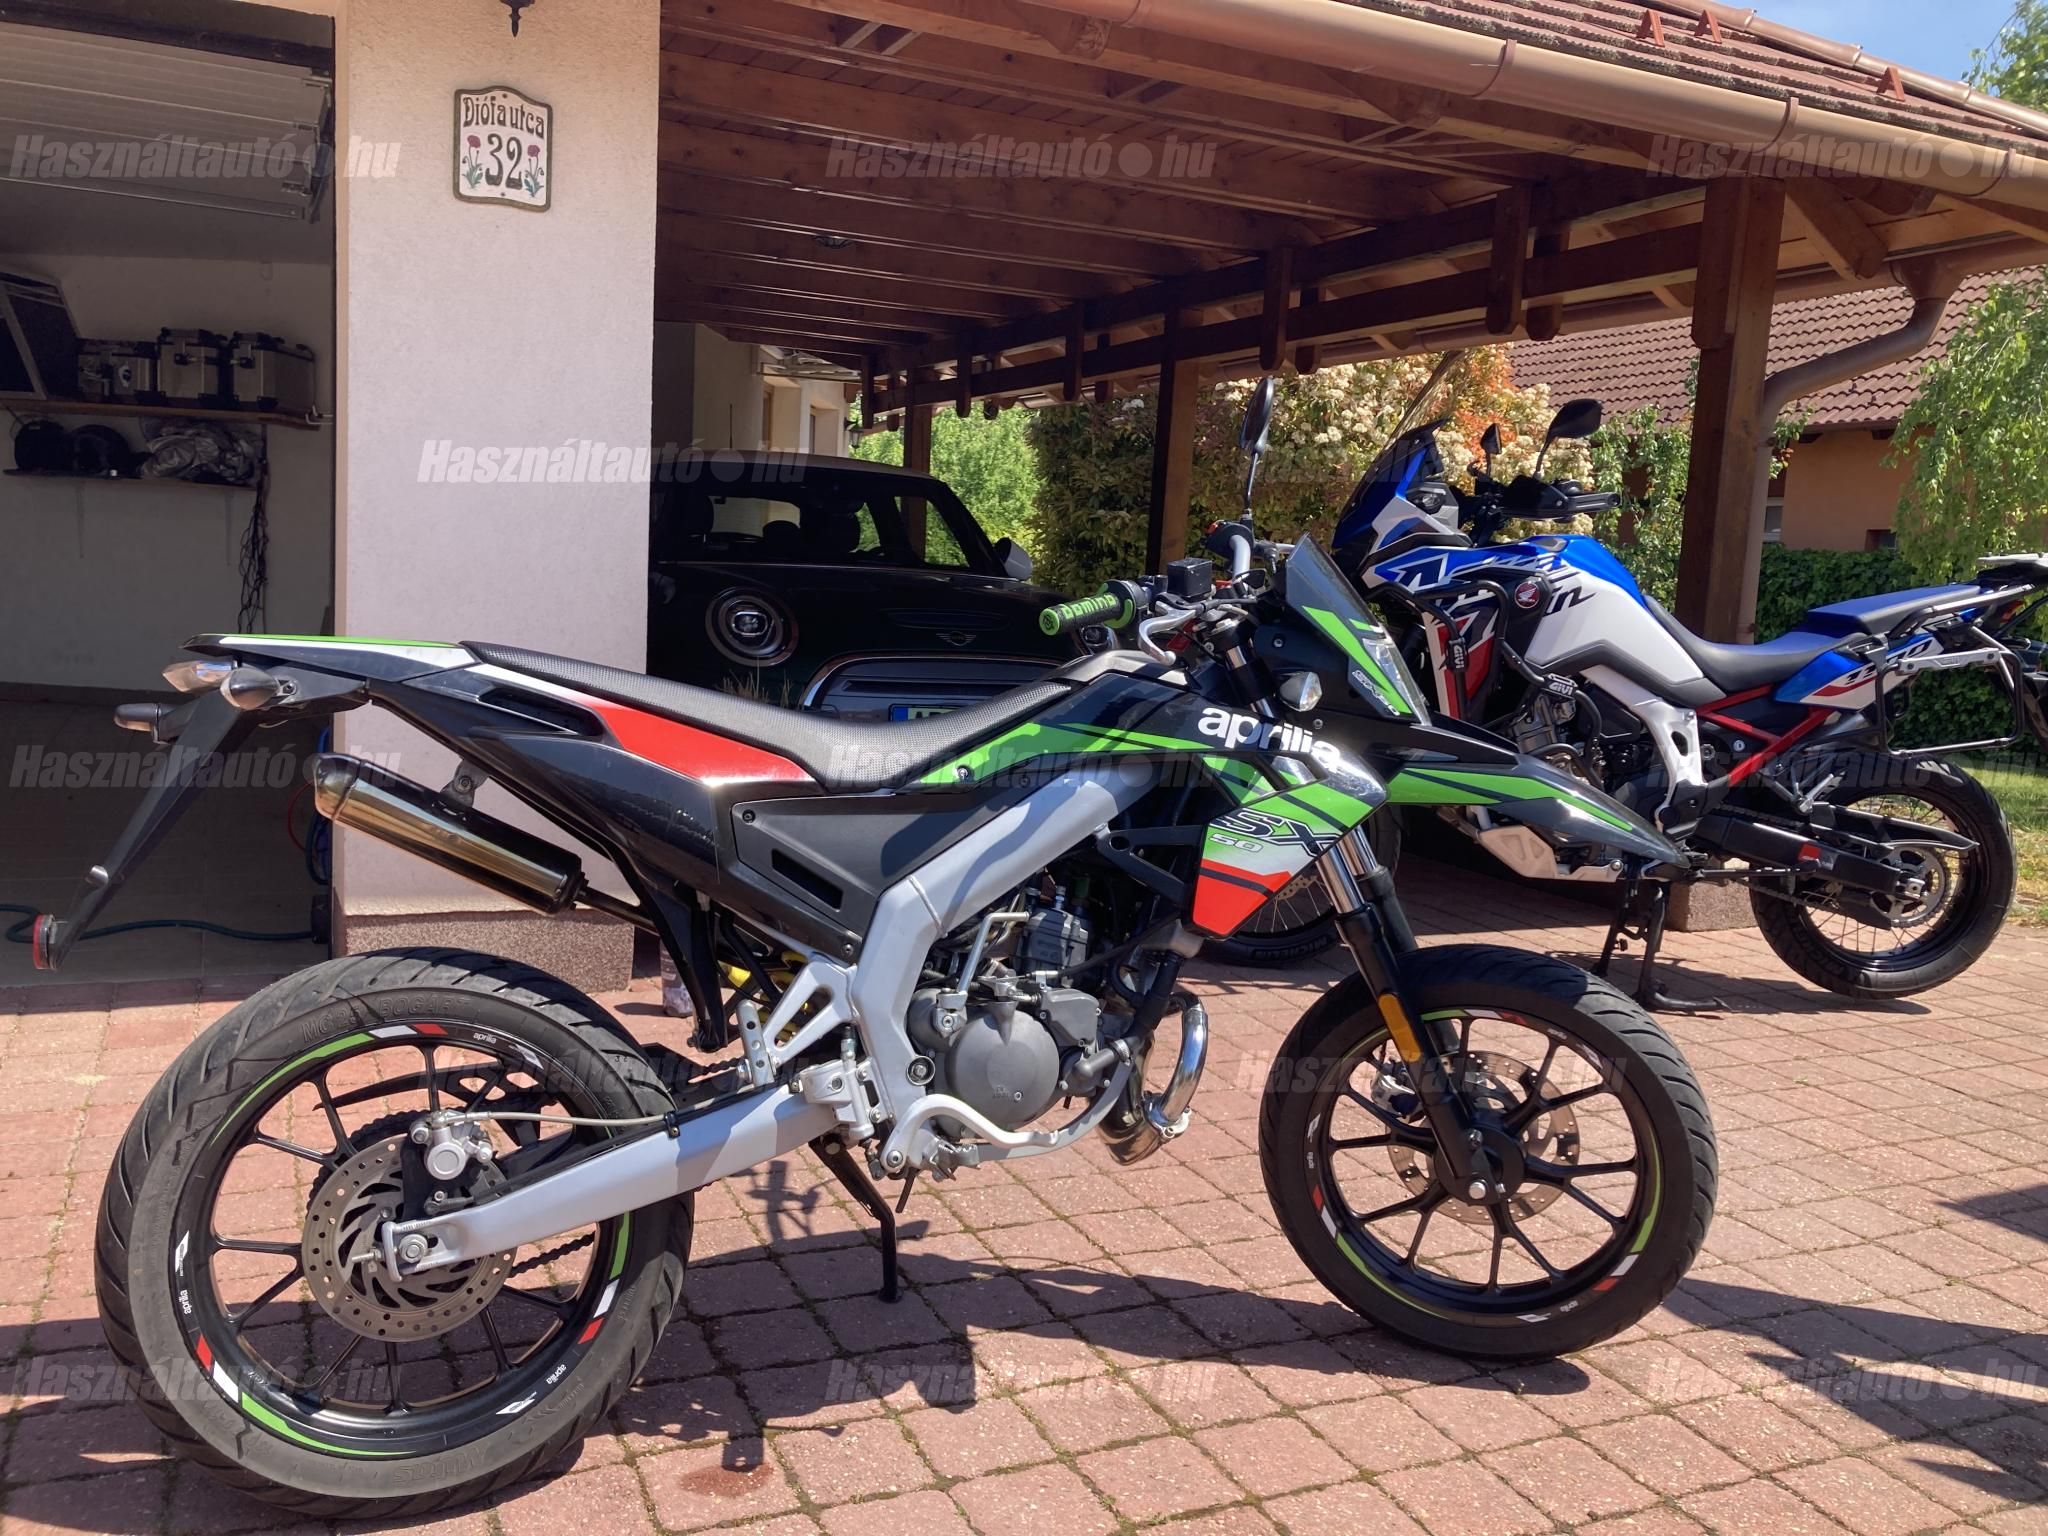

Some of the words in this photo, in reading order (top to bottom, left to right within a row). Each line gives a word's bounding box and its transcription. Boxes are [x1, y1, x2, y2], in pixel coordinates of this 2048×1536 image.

[462, 96, 506, 128] Diófa
[509, 104, 545, 139] utca
[484, 133, 523, 190] 32
[1453, 644, 1465, 669] GIVI
[1548, 681, 1574, 696] GIVI
[1198, 707, 1341, 772] aprilia
[1209, 807, 1342, 858] SX
[1209, 832, 1264, 853] 50
[473, 1032, 497, 1044] aprilia
[178, 1289, 193, 1315] aprilia
[545, 1363, 567, 1385] aprilia
